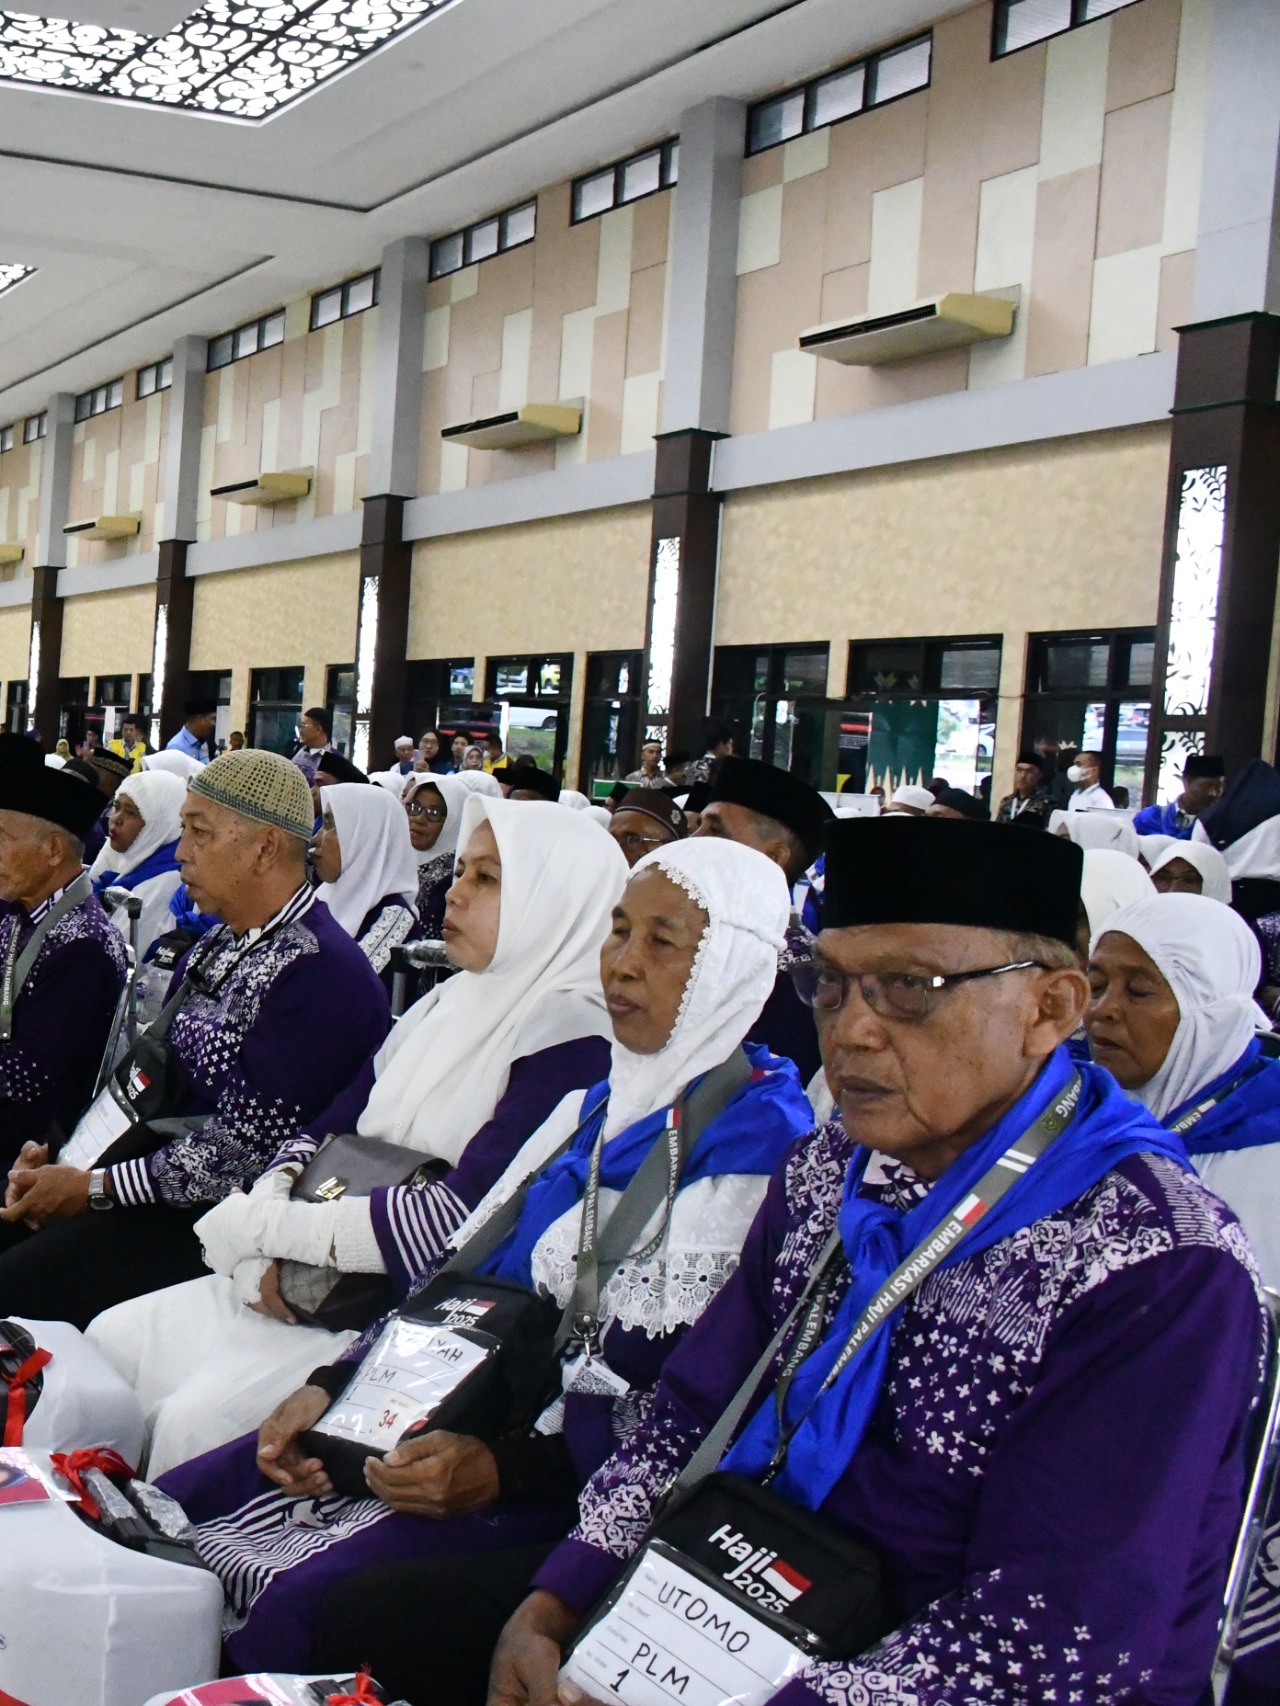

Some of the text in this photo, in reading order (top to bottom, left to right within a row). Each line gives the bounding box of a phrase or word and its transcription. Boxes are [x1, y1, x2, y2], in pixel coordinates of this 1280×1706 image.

[2, 966, 12, 1006] PALEMBANG
[582, 1192, 595, 1252] PALEMBANG
[890, 1220, 963, 1296] EMBARKASI
[434, 1297, 477, 1323] Haji
[448, 1314, 480, 1327] 2025
[864, 1291, 894, 1325] HAJI
[782, 1294, 824, 1377] PALEMBANG
[378, 1409, 398, 1429] 34
[708, 1523, 778, 1581] Haji
[734, 1573, 790, 1614] 2025
[657, 1581, 750, 1653] UTOMO
[610, 1668, 630, 1693] 1
[631, 1642, 690, 1695] PLM
